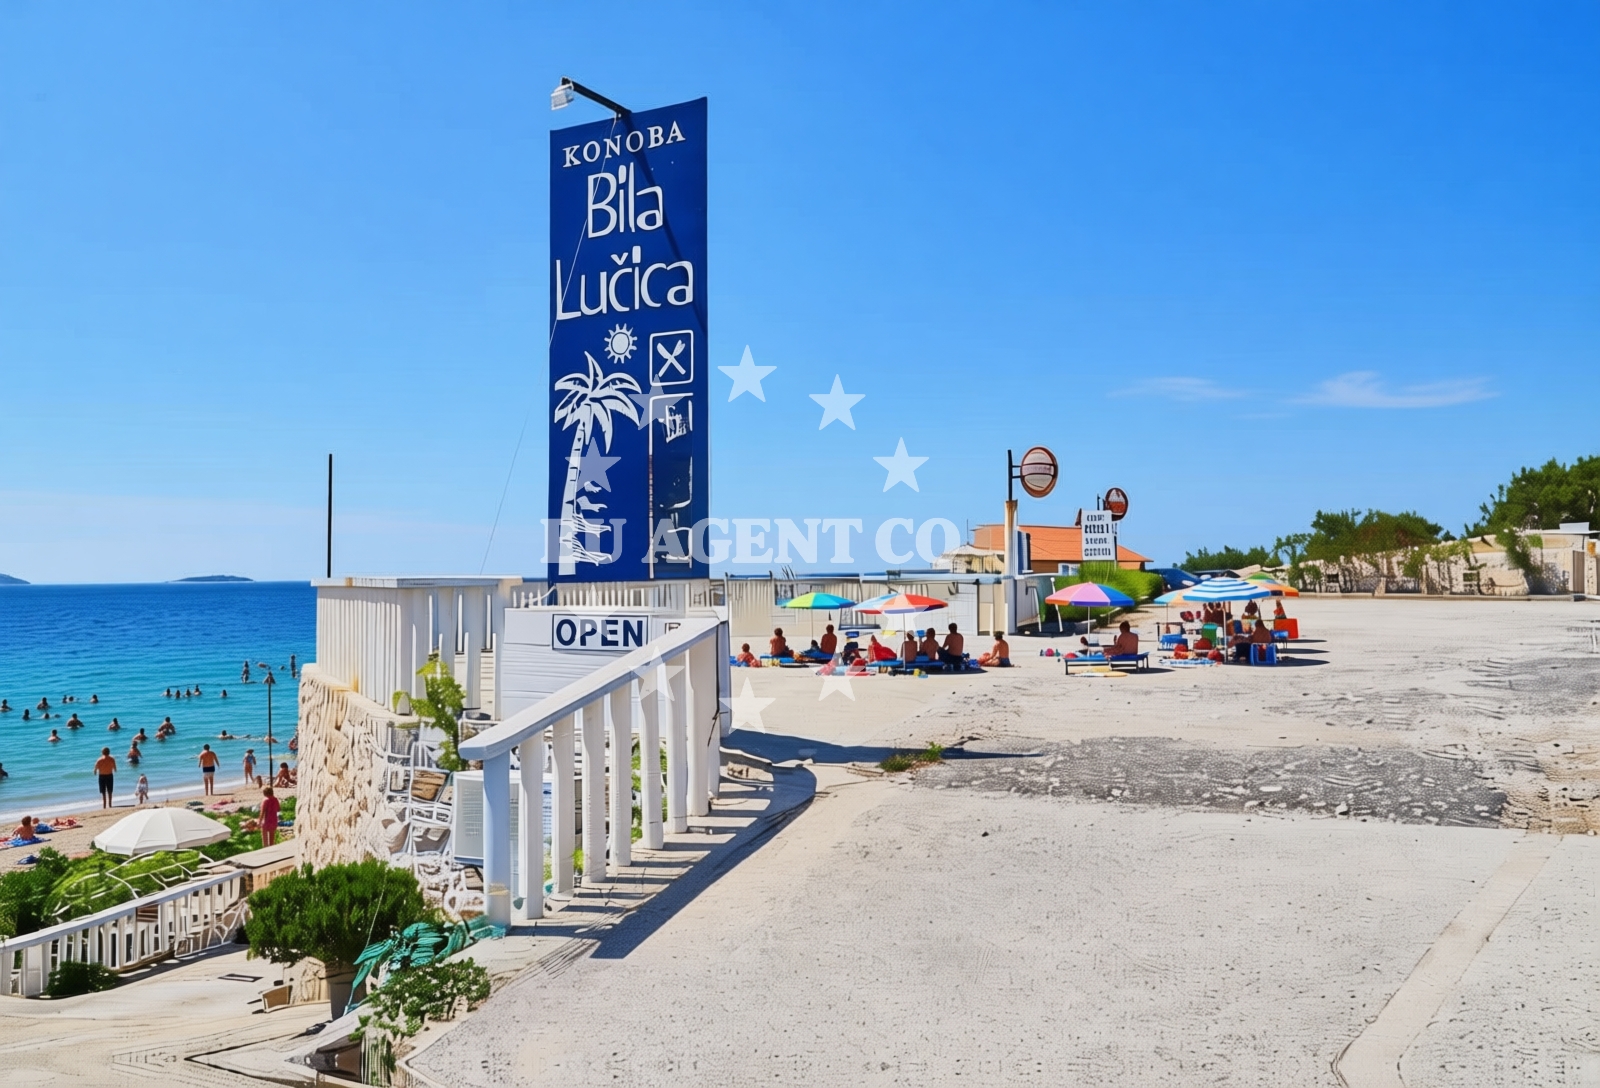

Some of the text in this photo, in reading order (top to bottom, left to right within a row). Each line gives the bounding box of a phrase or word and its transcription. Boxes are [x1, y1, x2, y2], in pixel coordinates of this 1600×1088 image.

[562, 120, 686, 168] KONOBA
[586, 161, 663, 238] Bila
[555, 245, 694, 321] Lučica
[556, 618, 643, 648] OPEN
